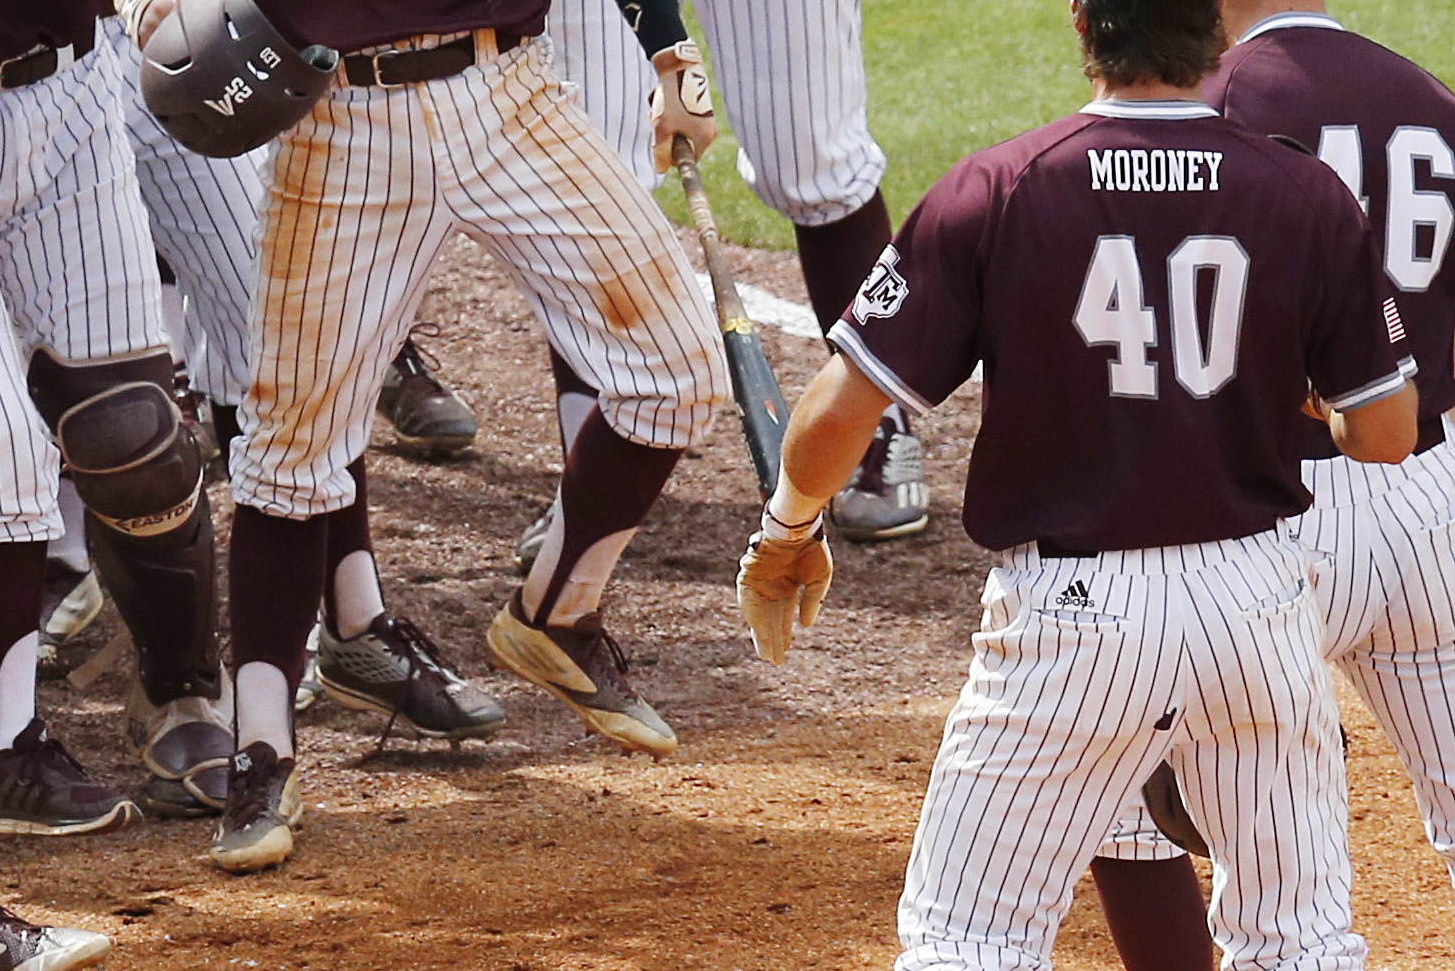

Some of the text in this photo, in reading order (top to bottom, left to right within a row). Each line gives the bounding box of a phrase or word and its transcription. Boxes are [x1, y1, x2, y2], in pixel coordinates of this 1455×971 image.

[1087, 149, 1223, 192] MORONEY
[1072, 234, 1251, 400] 40
[131, 499, 195, 529] EASTON
